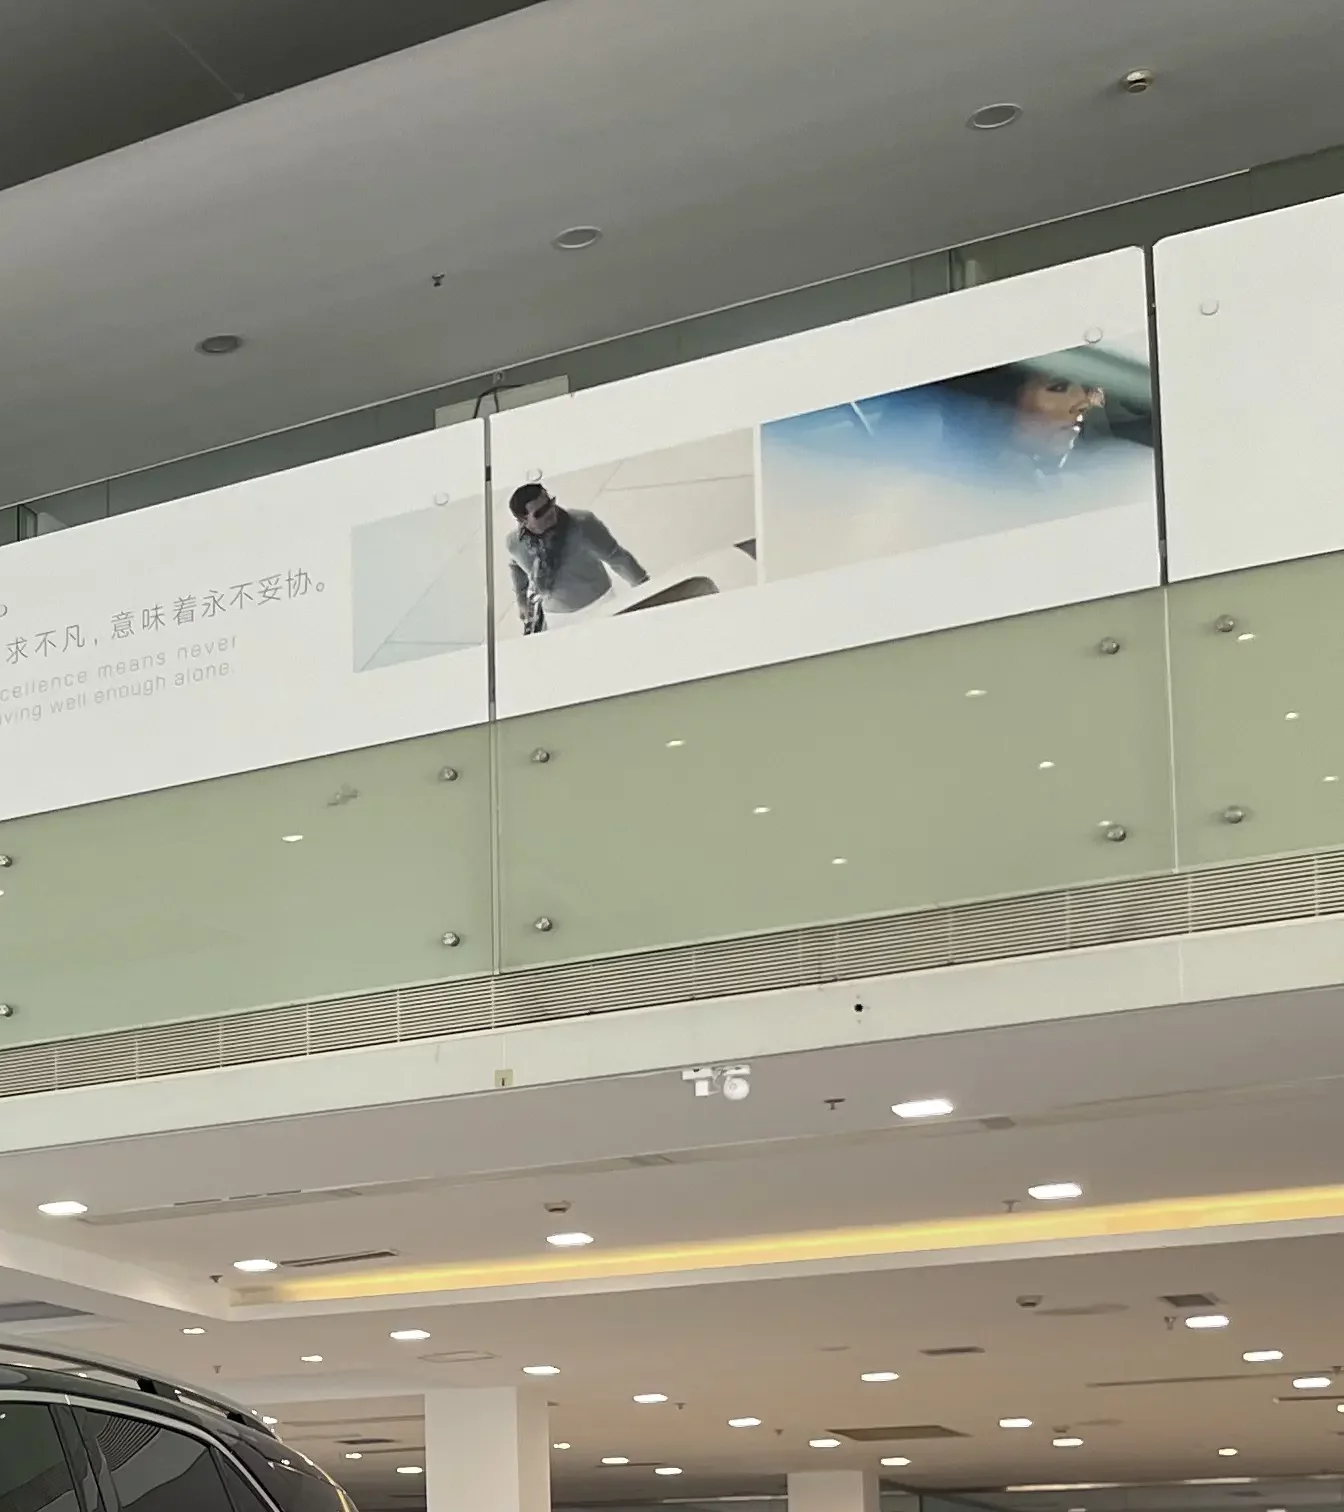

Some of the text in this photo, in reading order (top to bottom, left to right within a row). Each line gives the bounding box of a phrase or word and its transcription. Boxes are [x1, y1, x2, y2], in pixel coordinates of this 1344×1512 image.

[97, 649, 167, 680] means
[176, 634, 238, 660] never
[49, 691, 87, 715] well
[93, 676, 167, 705] enough
